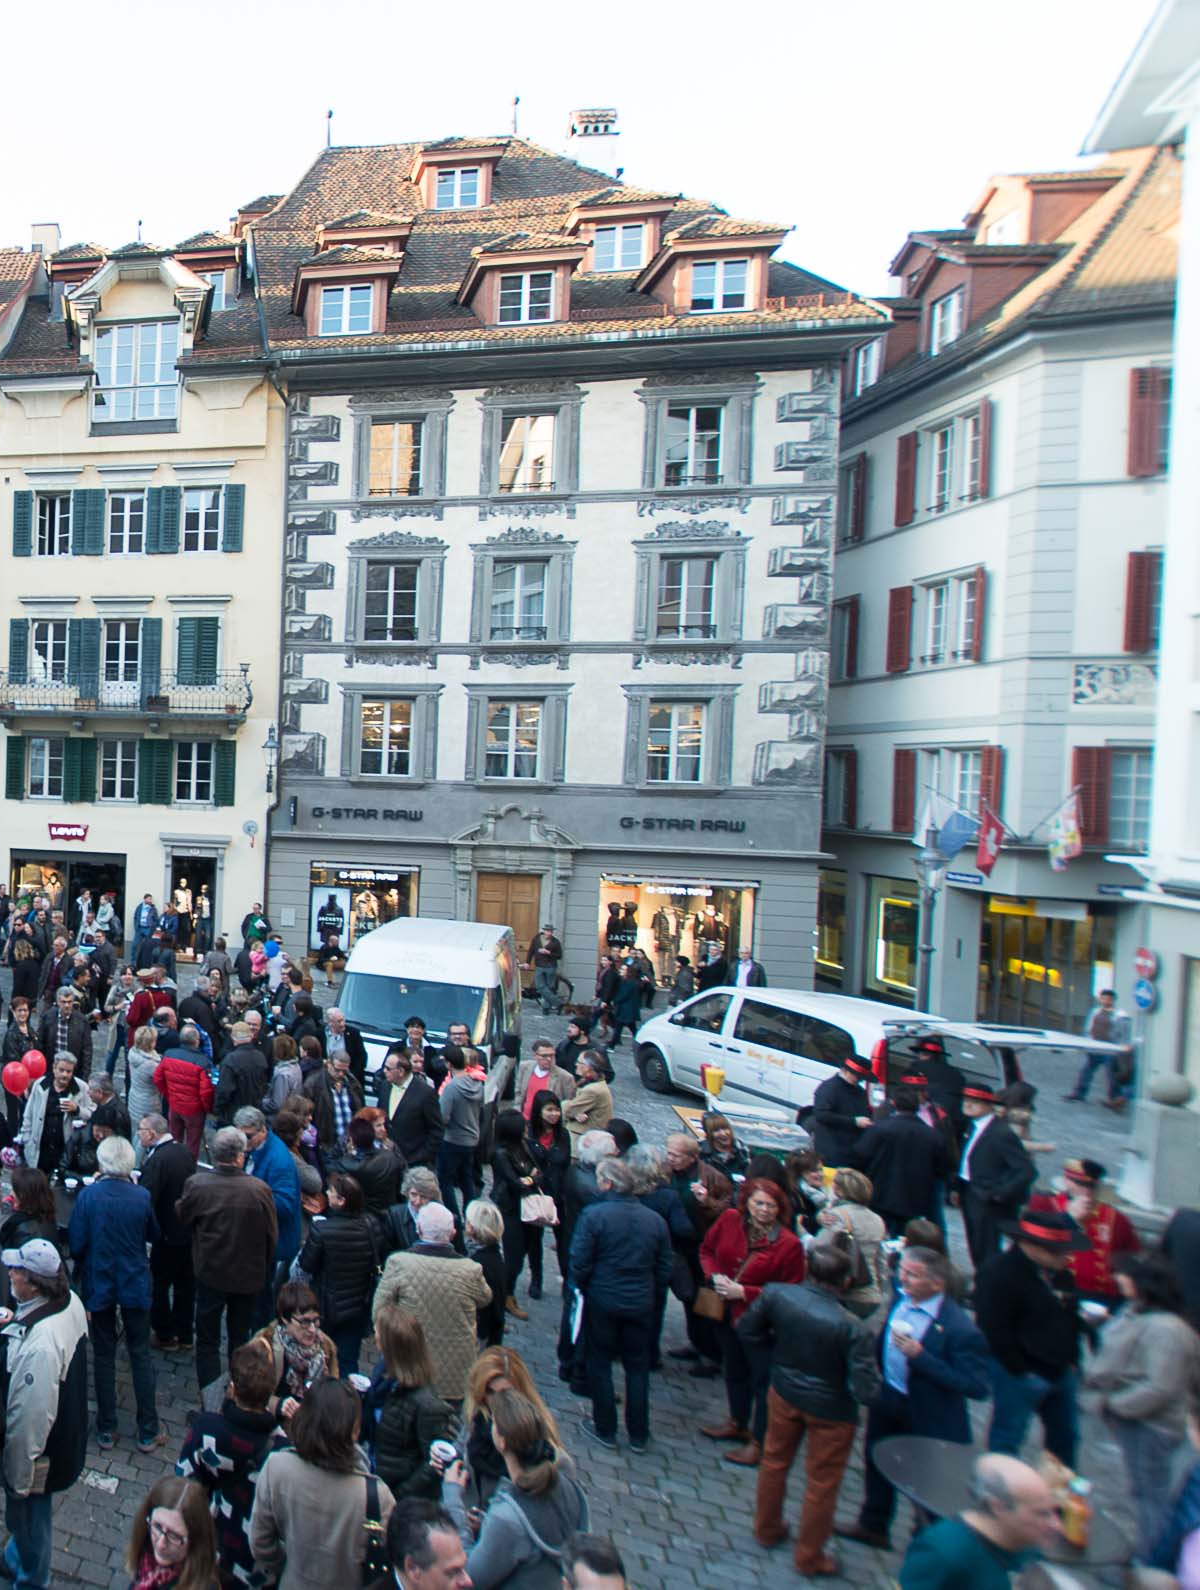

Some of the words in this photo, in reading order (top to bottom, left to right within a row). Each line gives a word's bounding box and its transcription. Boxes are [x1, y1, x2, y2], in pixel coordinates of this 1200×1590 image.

[312, 807, 378, 820] G-STAR
[383, 809, 423, 821] RAW
[619, 817, 696, 831] G-STAR
[700, 819, 746, 833] RAW
[376, 873, 398, 881] RAW
[687, 887, 712, 896] RAW
